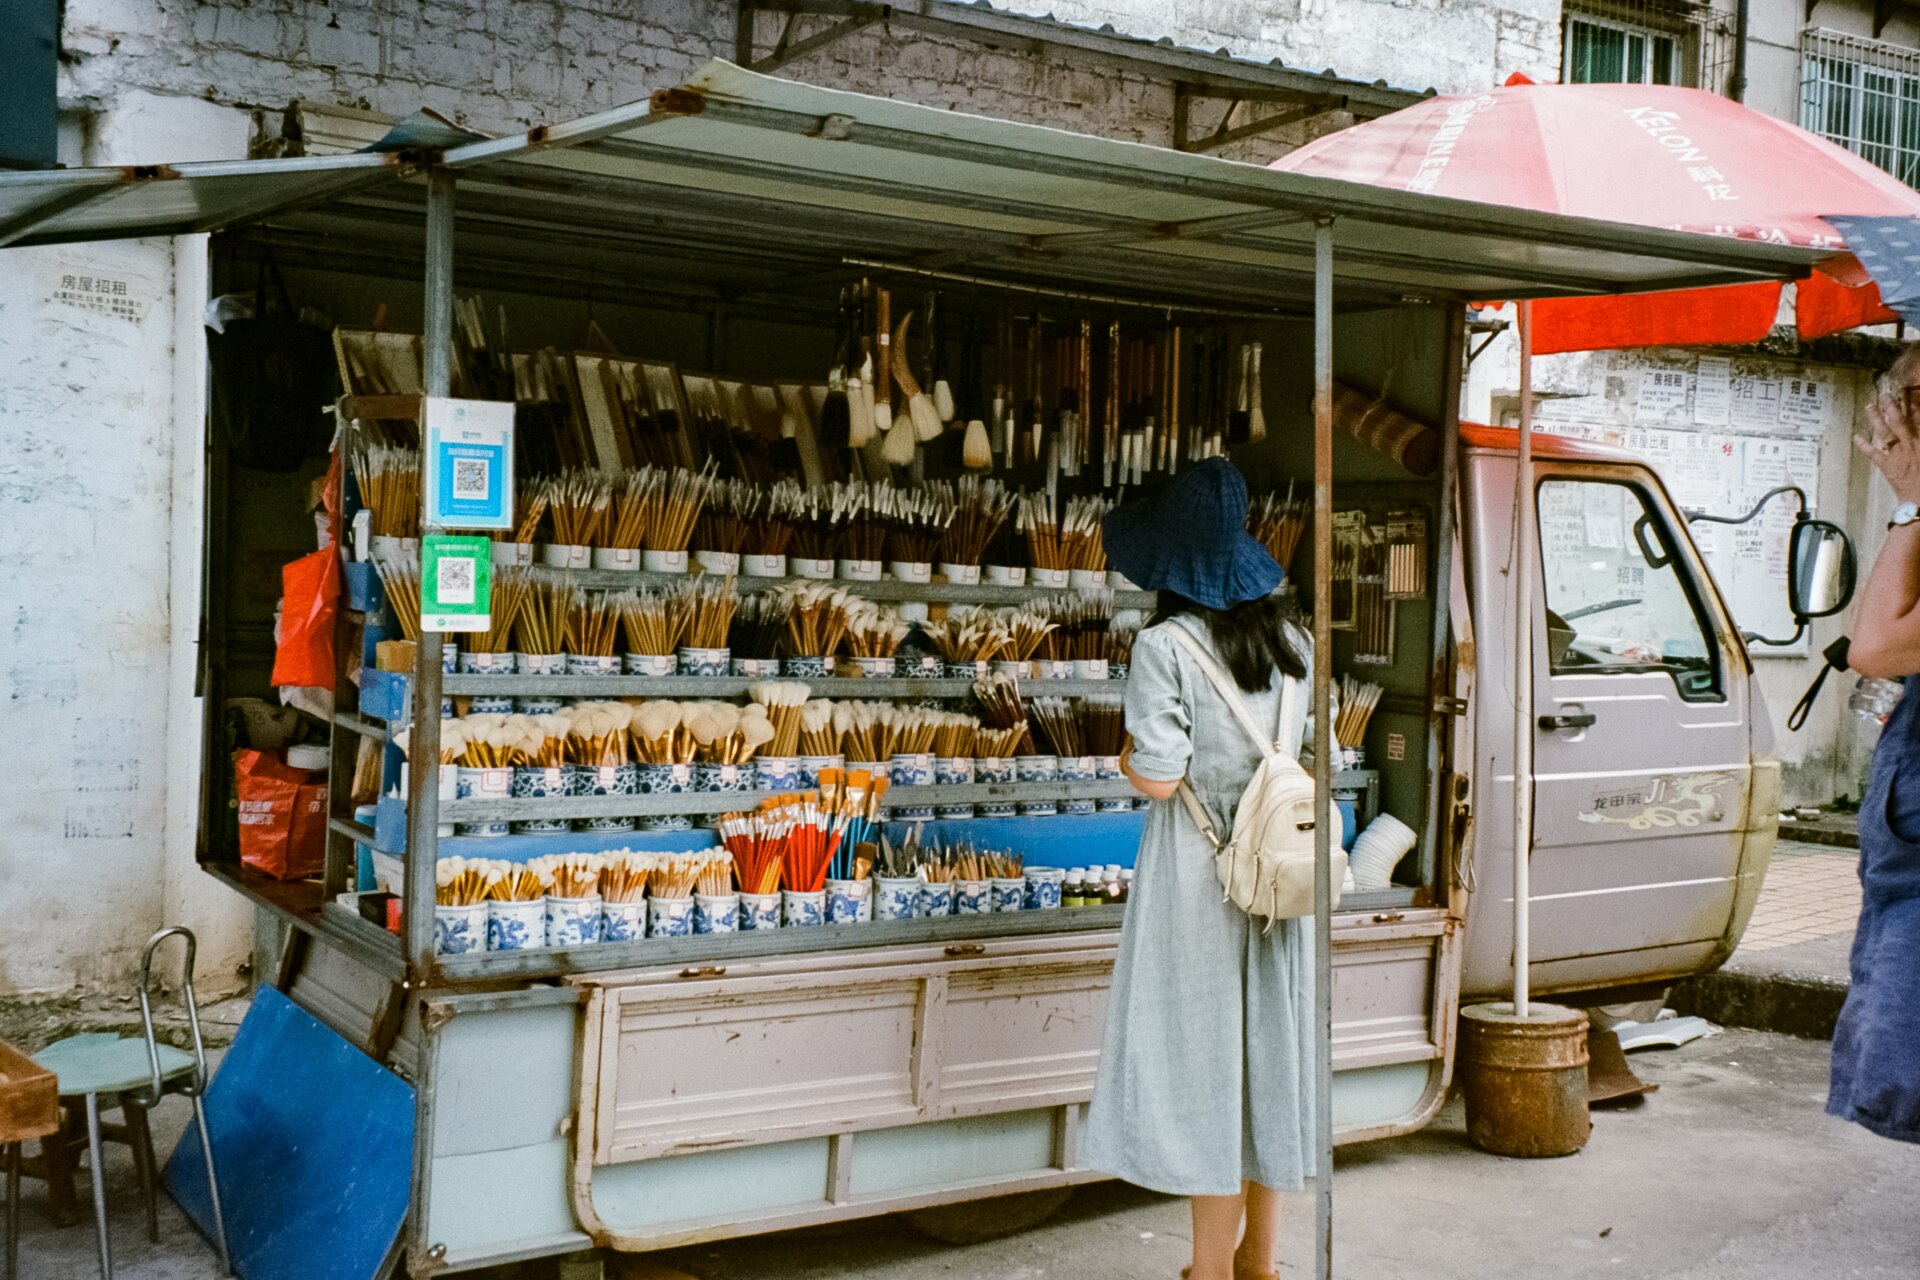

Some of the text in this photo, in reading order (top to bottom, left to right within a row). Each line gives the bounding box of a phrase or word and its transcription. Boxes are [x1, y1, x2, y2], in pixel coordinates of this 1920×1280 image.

[1624, 106, 1708, 162] KELON
[61, 275, 127, 296] 房屋招租
[1643, 372, 1683, 388] 厂房招租
[1790, 380, 1818, 397] 招租
[1735, 379, 1777, 401] 招工
[1629, 434, 1670, 450] 房屋出租
[1617, 566, 1645, 585] 招聘
